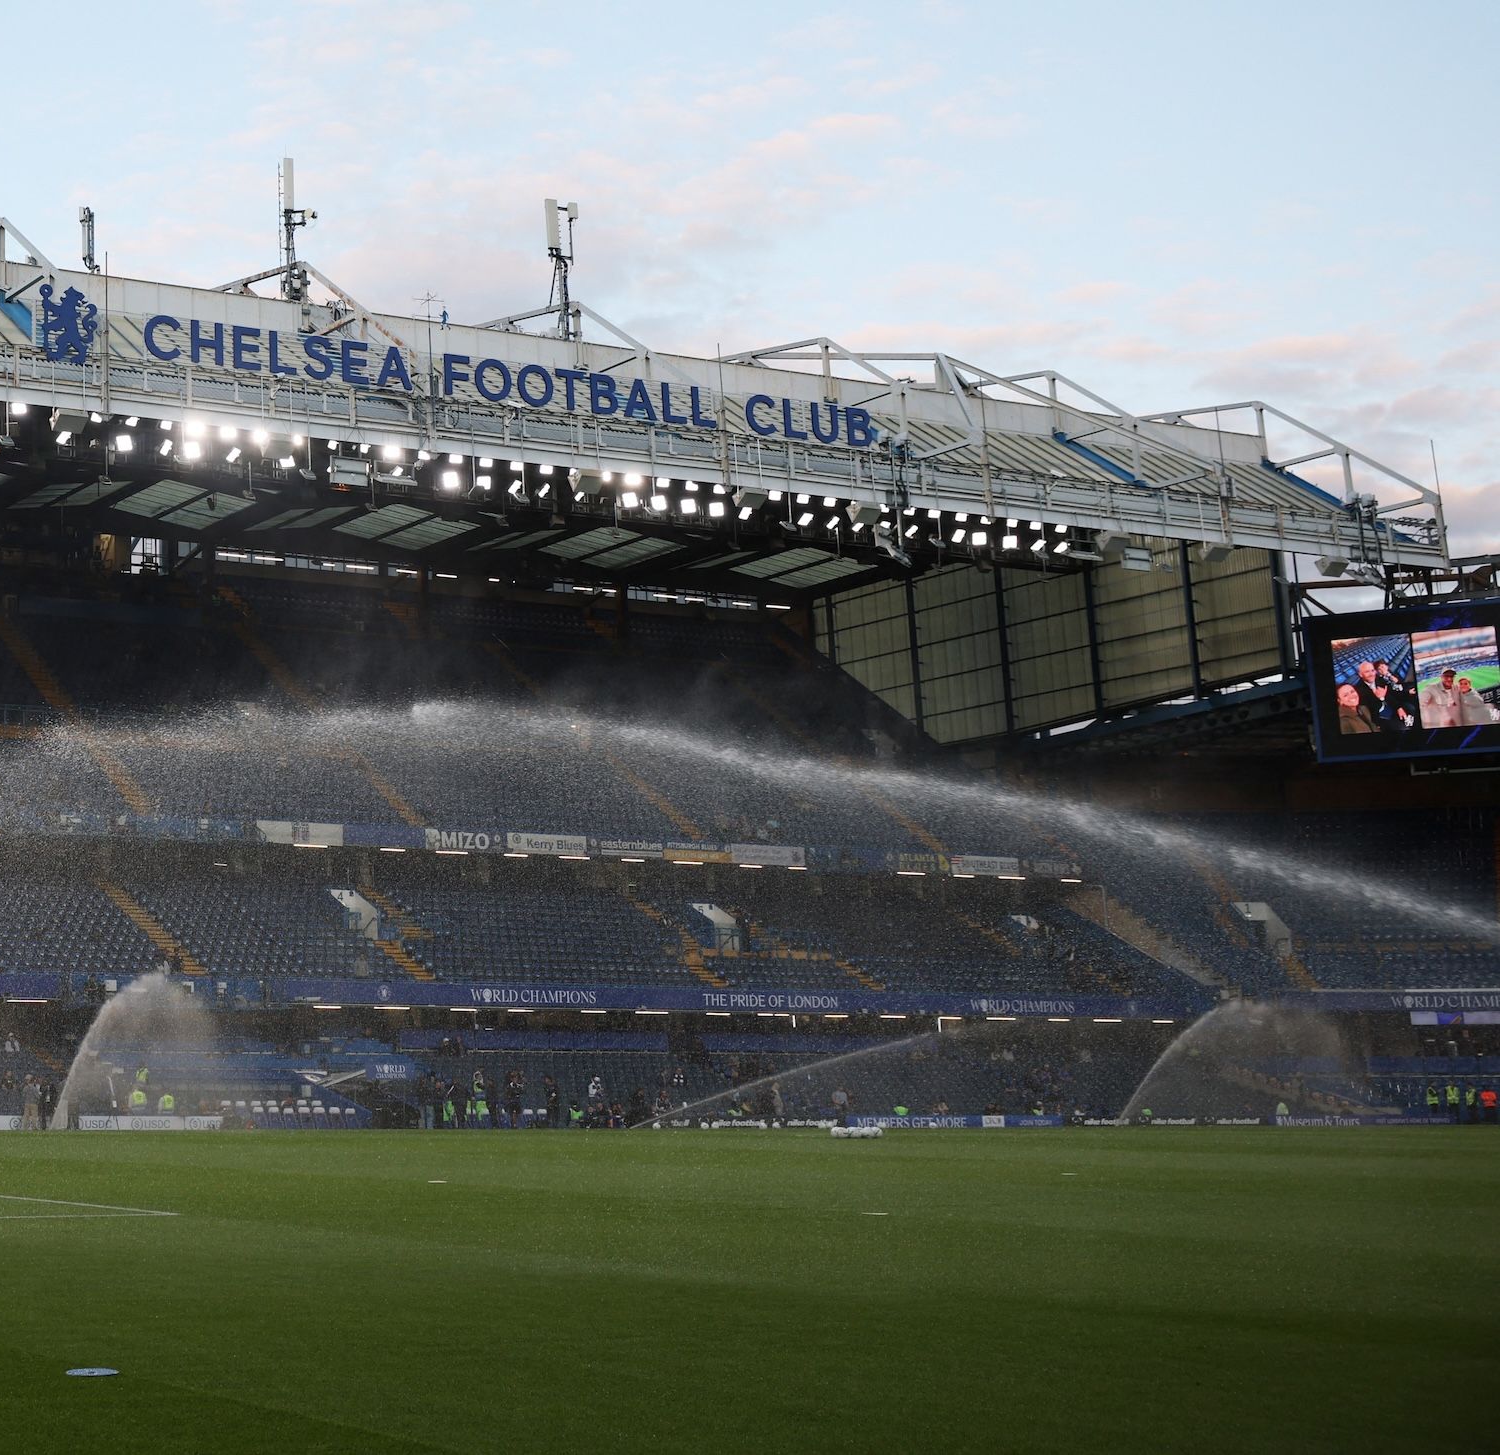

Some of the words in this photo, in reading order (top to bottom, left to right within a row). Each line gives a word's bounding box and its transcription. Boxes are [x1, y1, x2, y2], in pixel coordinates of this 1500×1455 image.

[143, 314, 413, 391] CHELSEA
[442, 353, 717, 429] FOOTBALL
[745, 394, 874, 447] CLUB
[441, 831, 490, 850] MIZO
[526, 837, 553, 850] Kerry
[556, 838, 584, 850] Blues
[600, 838, 663, 851] easternblues
[337, 892, 344, 901] 4
[698, 905, 704, 914] 5
[1244, 903, 1252, 914] 1
[471, 988, 519, 1003] WORLD
[520, 989, 597, 1004] CHAMPIONS
[702, 993, 728, 1007] THE
[730, 994, 766, 1008] PRIDE
[768, 994, 785, 1008] OF
[787, 995, 839, 1009] LONDON
[1390, 995, 1445, 1008] WORLD
[970, 999, 1011, 1012] WORLD
[1011, 999, 1076, 1014] CHAMPIONS
[375, 1063, 406, 1074] WORLD
[84, 1119, 112, 1129] USDC
[144, 1119, 171, 1129] USDC
[202, 1119, 221, 1129] USD
[787, 1119, 805, 1127] nike
[857, 1117, 910, 1129] MEMBERS
[912, 1117, 934, 1129] GET
[936, 1117, 967, 1129] MORE
[1084, 1118, 1101, 1126] nike
[1151, 1118, 1167, 1126] nike
[1167, 1118, 1197, 1126] football
[1216, 1117, 1232, 1125] nike
[1232, 1117, 1260, 1125] football
[1284, 1116, 1325, 1127] Museum
[1325, 1116, 1333, 1127] &
[1333, 1116, 1361, 1127] Tours
